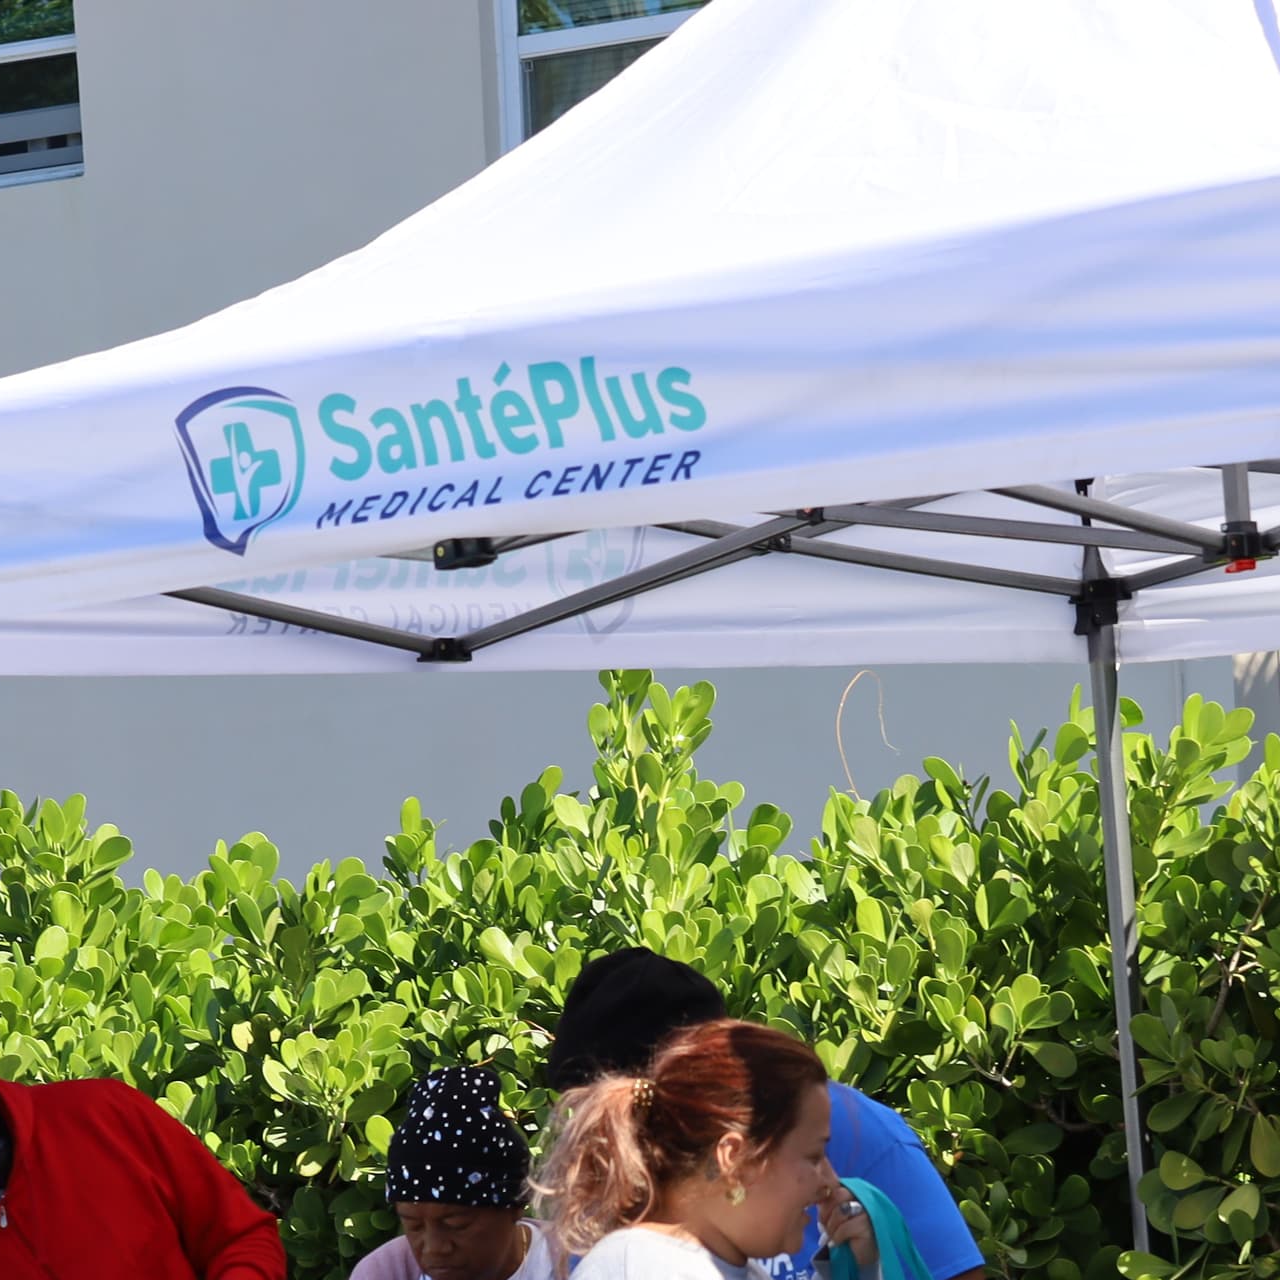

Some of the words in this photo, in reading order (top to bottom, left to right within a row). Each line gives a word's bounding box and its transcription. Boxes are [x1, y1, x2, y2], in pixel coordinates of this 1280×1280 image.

[317, 355, 708, 482] SantéPlus
[316, 476, 504, 530] MEDICAL
[524, 449, 703, 499] CENTER
